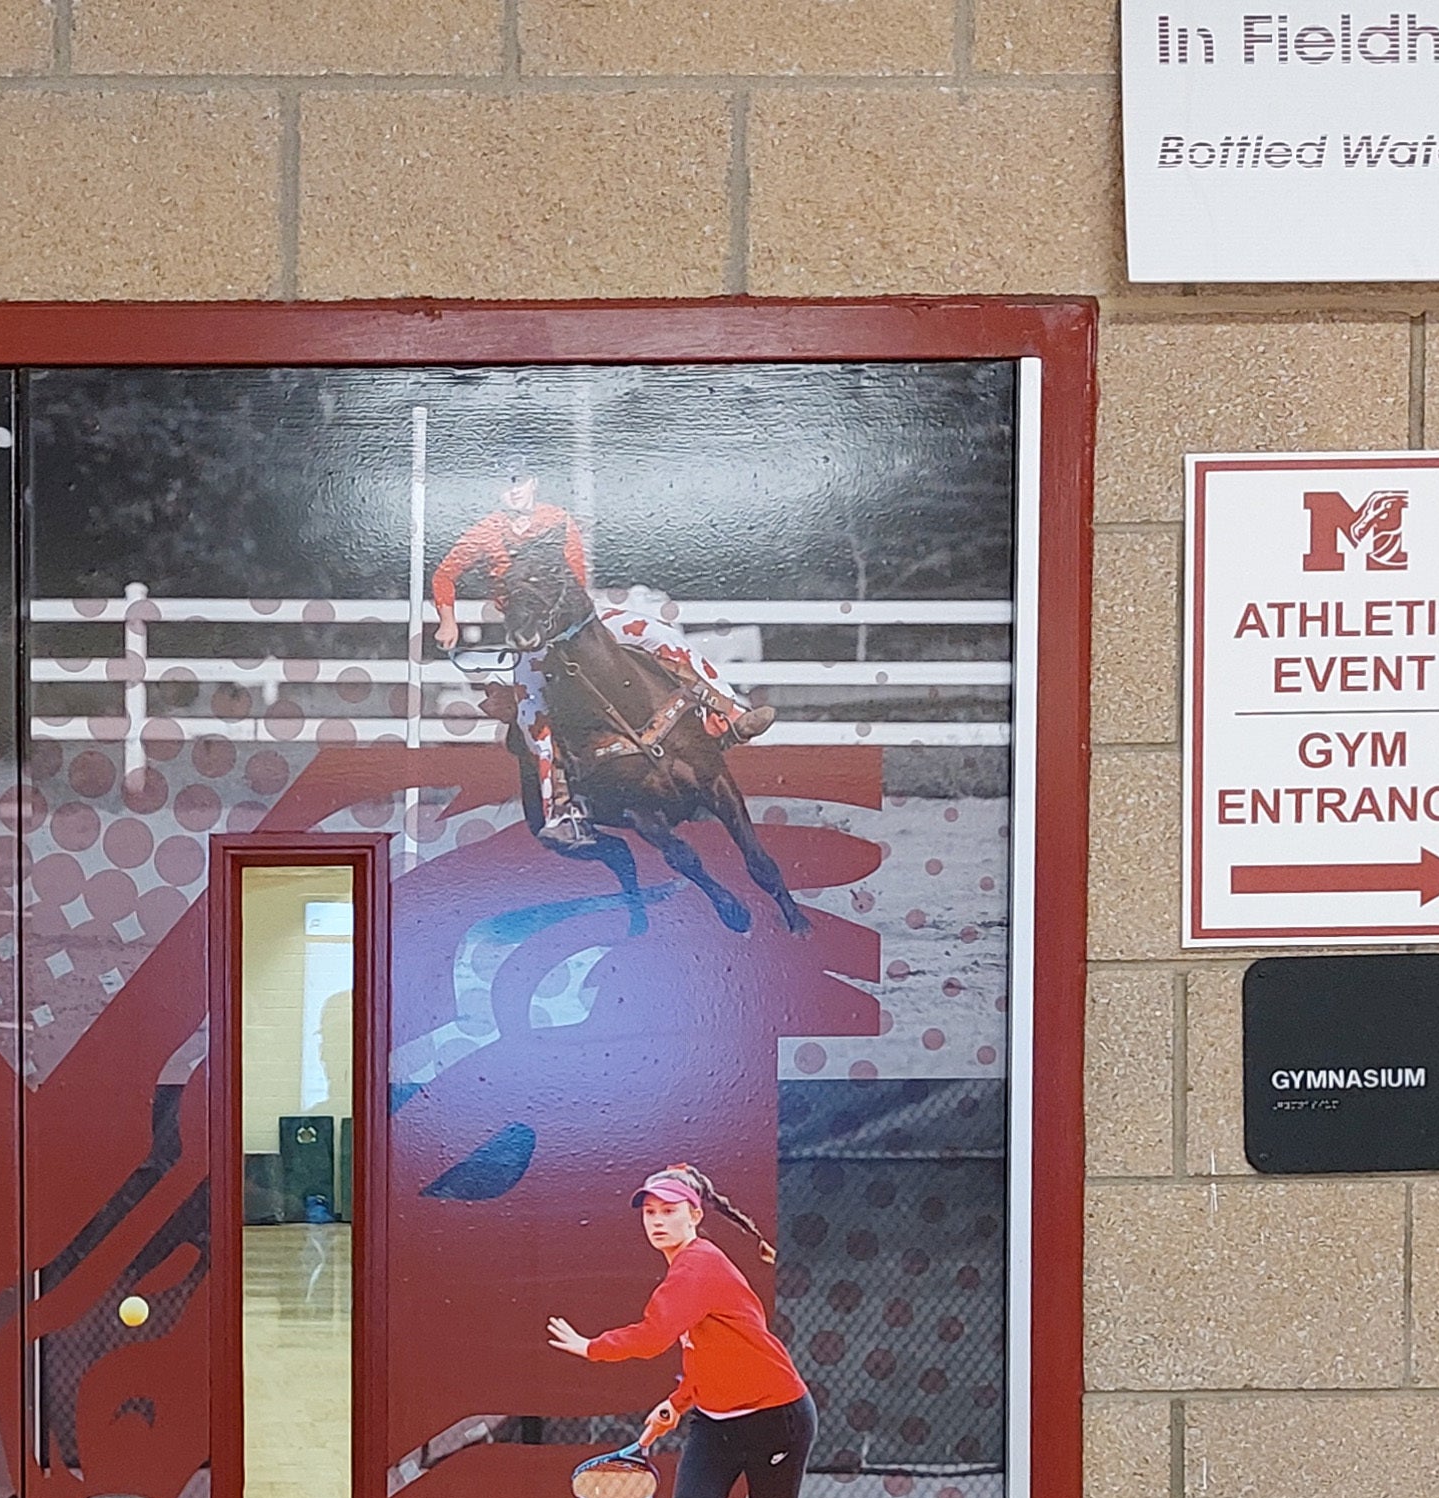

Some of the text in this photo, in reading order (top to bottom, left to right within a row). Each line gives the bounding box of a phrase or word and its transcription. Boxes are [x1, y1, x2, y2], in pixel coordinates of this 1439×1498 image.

[1157, 15, 1215, 64] In
[1157, 134, 1328, 168] Bottled
[1273, 655, 1436, 693] EVENT
[1297, 731, 1407, 769] GYM
[1271, 1067, 1426, 1090] GYMNASIUM
